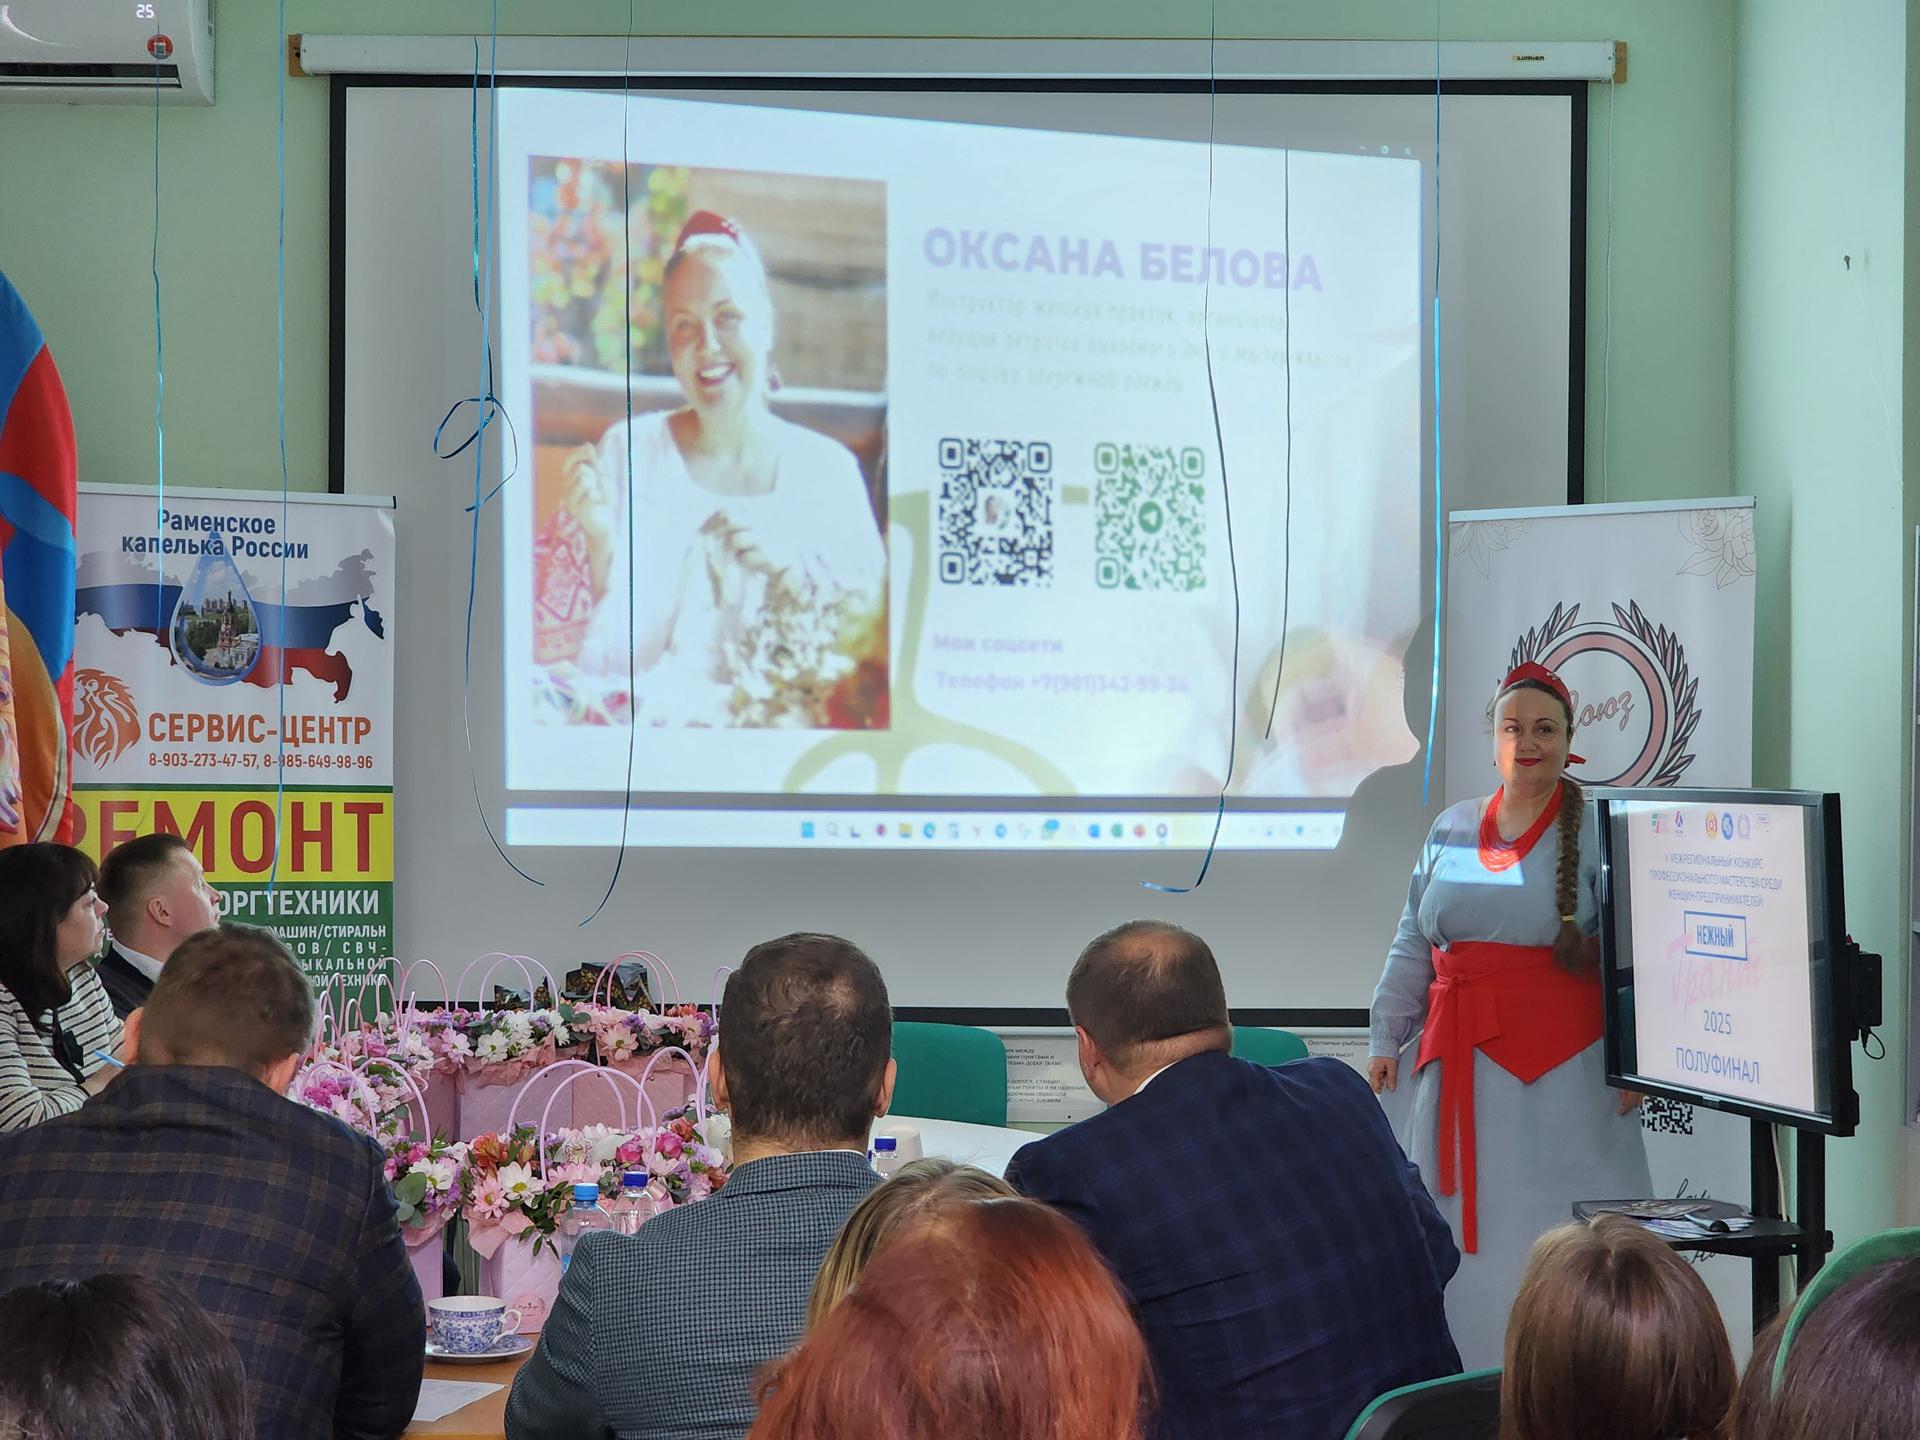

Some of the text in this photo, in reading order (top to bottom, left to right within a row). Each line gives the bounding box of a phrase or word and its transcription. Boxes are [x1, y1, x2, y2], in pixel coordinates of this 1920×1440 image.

[136, 4, 154, 18] 25
[923, 227, 1324, 292] ОКСАНА БЕЛОВА
[157, 509, 276, 535] Раменское
[122, 535, 309, 559] капелька России
[932, 634, 1063, 654] Мои соцсети
[936, 671, 1025, 693] Телефон
[148, 712, 372, 748] СЕРВИС-ЦЕНТР
[149, 753, 373, 770] 8-903-273-47-57, 8-985-649-98-96
[1734, 856, 1764, 870] КОНКУРС
[1719, 874, 1760, 889] МАСТЕРСТВА
[1760, 877, 1783, 890] СРЕДИ
[219, 889, 379, 916] ОРГТЕХНИКИ
[1696, 924, 1735, 949] НЕЖНЫЙ
[1703, 1010, 1732, 1035] 2025
[1676, 1047, 1760, 1084] ПОЛУФИНАЛ
